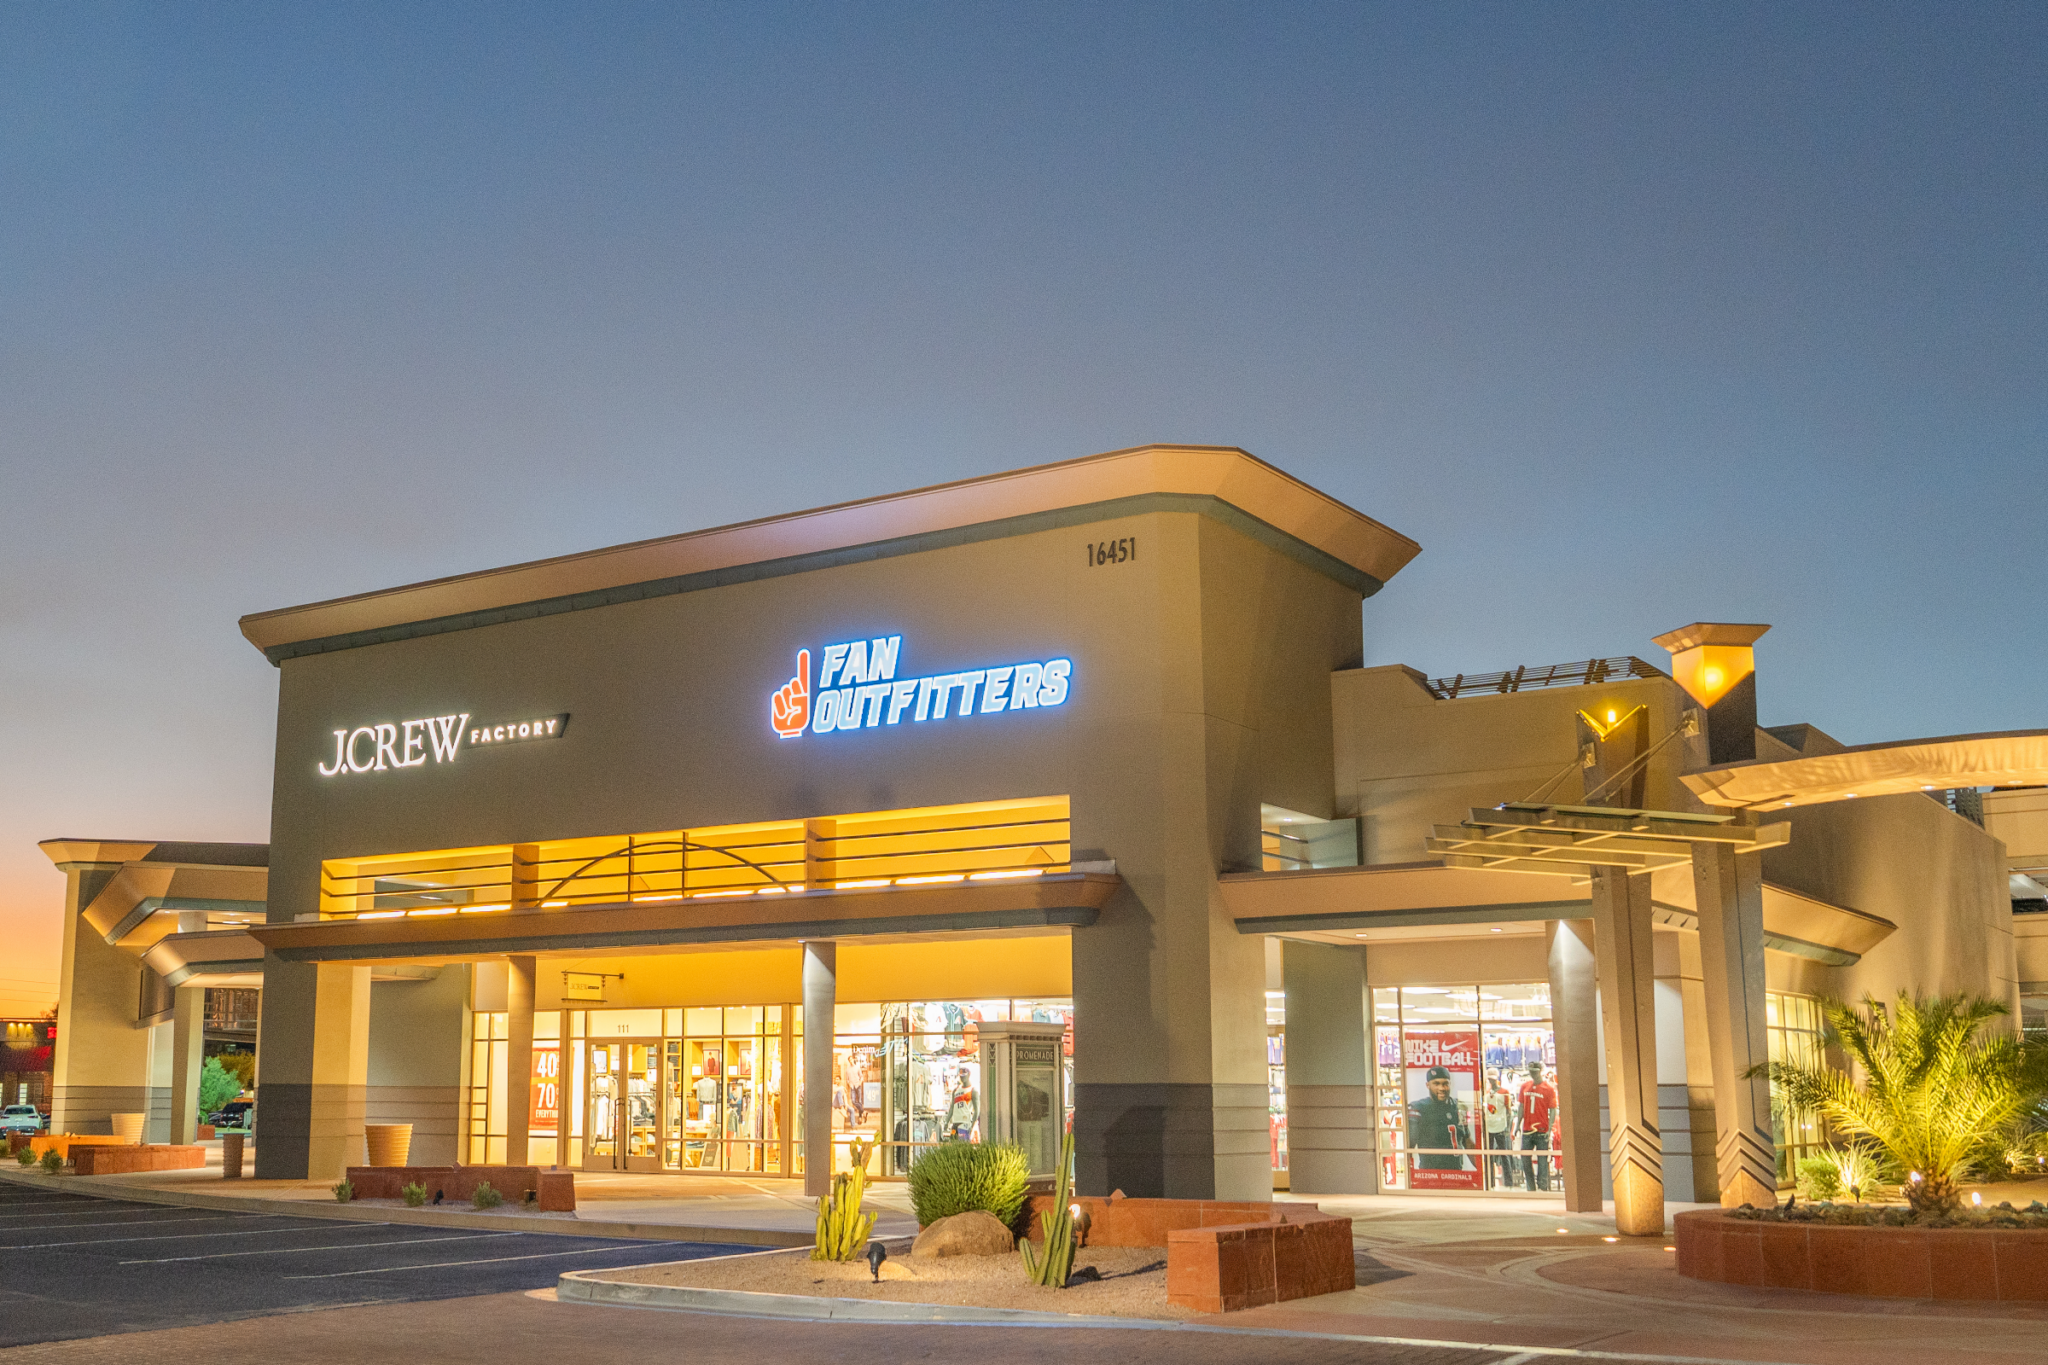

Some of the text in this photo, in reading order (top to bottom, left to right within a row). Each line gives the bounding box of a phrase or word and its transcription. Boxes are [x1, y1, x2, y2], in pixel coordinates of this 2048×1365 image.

[1087, 537, 1135, 567] 16451
[818, 635, 901, 688] FAN
[812, 658, 1071, 733] OUTFITTERS
[318, 713, 557, 776] J.CREW FACTORY
[617, 1024, 629, 1034] 111
[1405, 1039, 1439, 1052] NIKE
[1016, 1050, 1054, 1061] PROMENADE
[1405, 1052, 1474, 1066] FOOTBALL
[536, 1053, 557, 1078] 40
[537, 1083, 556, 1108] 70
[957, 1101, 965, 1109] 13
[536, 1109, 558, 1118] EVERYTHI
[1414, 1172, 1473, 1181] ARIZONA CARDINALS
